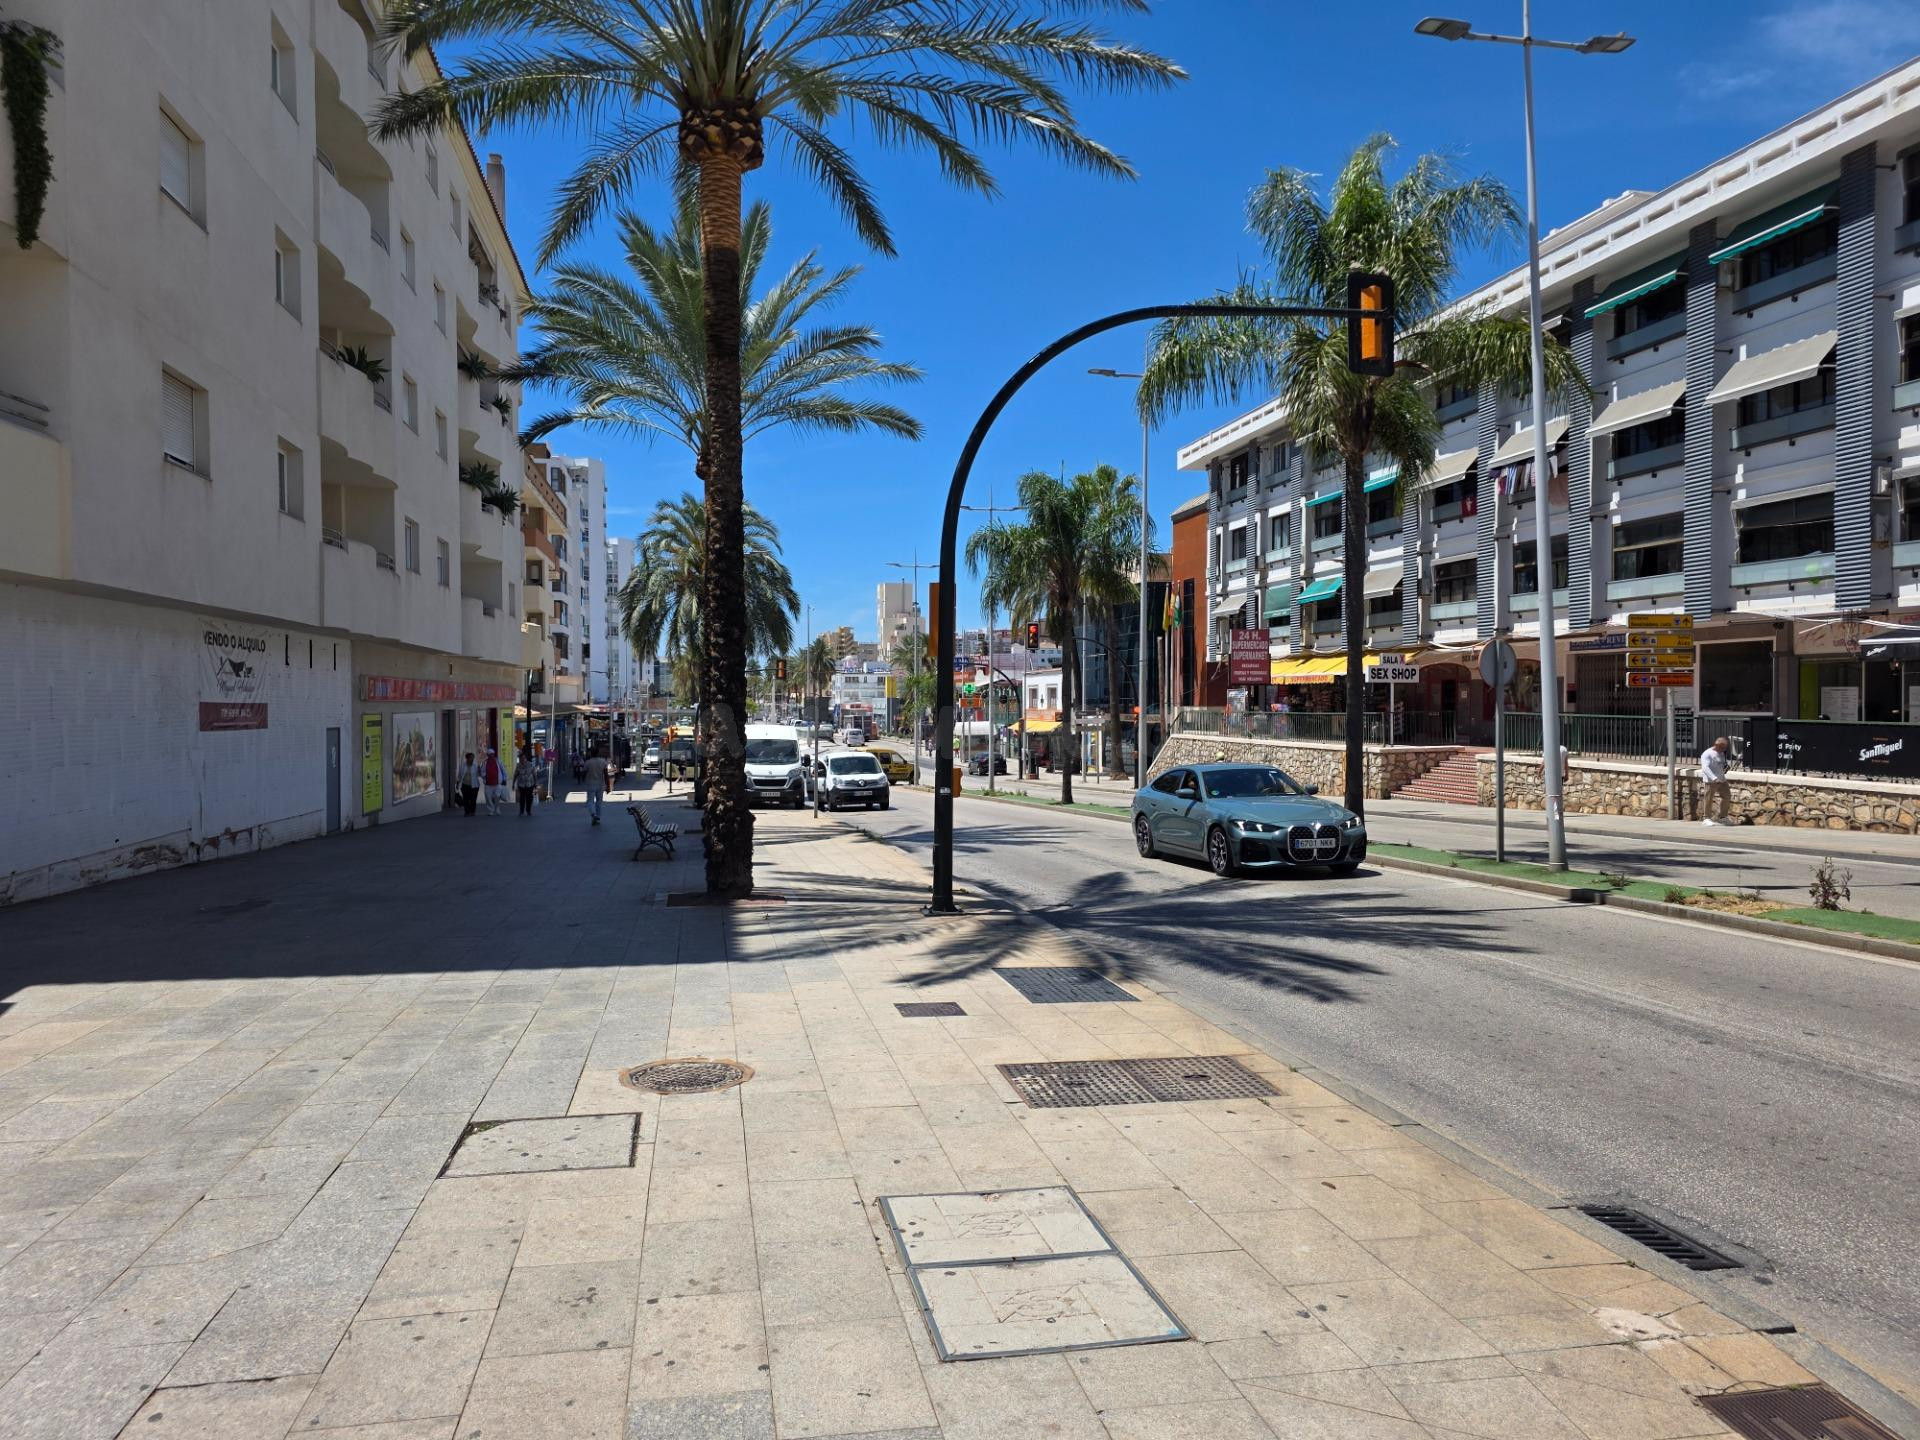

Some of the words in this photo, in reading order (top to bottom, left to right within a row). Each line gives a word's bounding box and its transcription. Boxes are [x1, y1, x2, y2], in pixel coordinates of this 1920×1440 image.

[1238, 631, 1250, 640] 24
[203, 630, 230, 648] VENDO
[231, 635, 237, 649] O
[237, 636, 266, 654] ALQUILO
[1232, 640, 1268, 650] SUPERMERCADO
[1232, 651, 1268, 661] SUPERMARKET
[1382, 656, 1398, 664] SALA
[1400, 654, 1406, 664] X
[1371, 668, 1389, 680] SEX
[1391, 668, 1417, 680] SHOP
